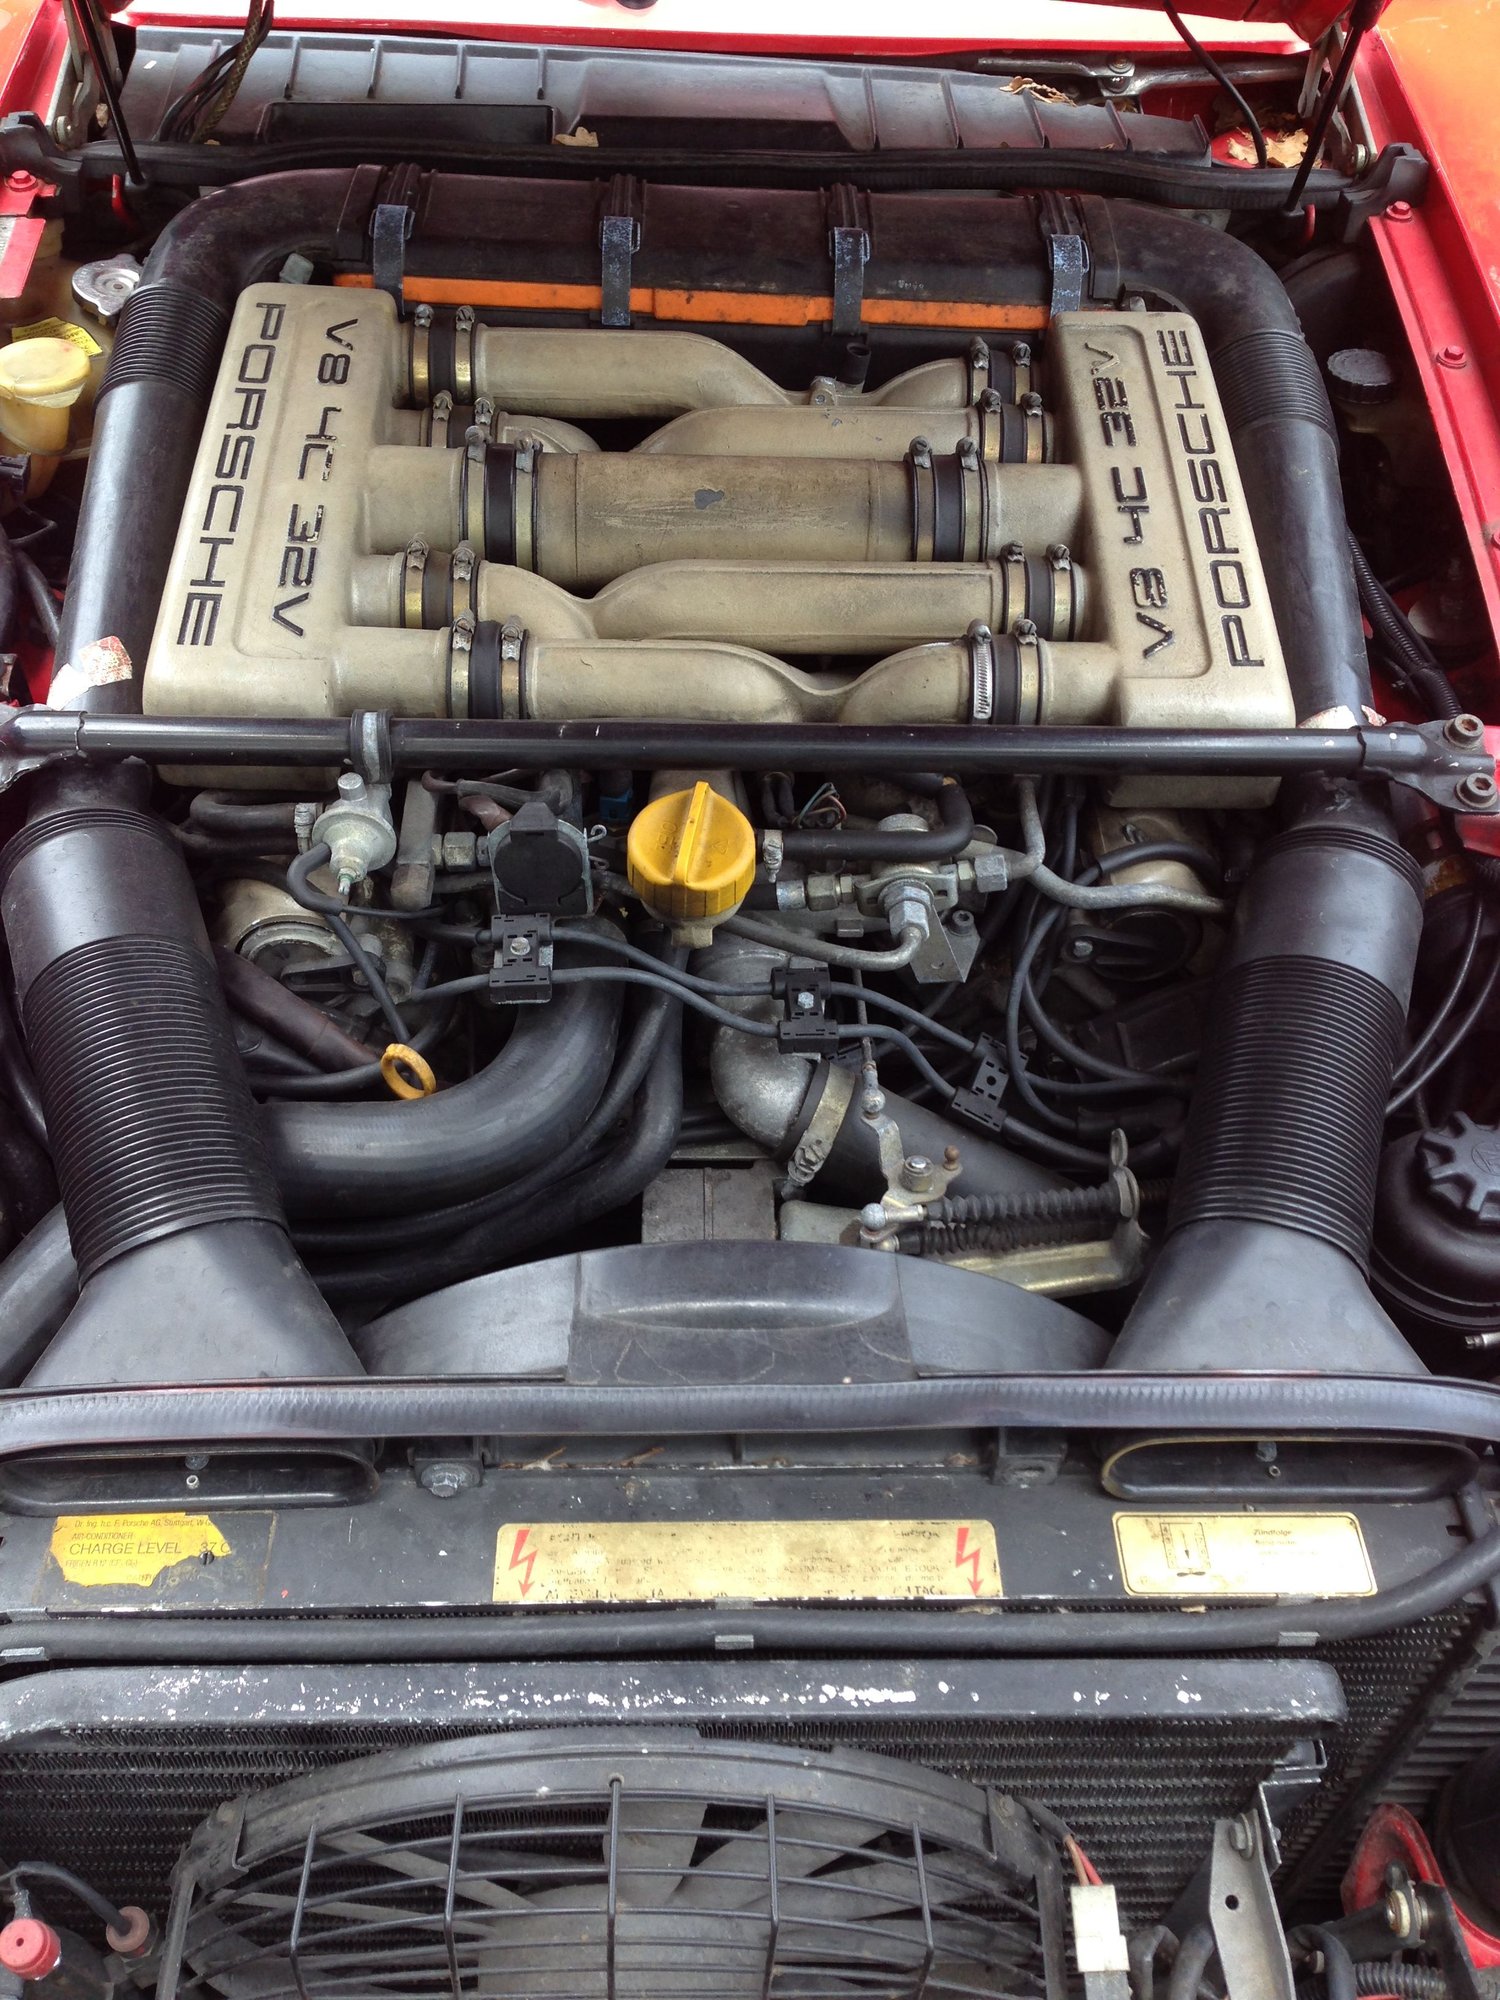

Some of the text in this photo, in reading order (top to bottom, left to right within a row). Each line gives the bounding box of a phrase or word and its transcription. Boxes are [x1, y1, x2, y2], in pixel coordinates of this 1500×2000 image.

[317, 318, 359, 386] V8
[1084, 342, 1139, 448] 32V
[177, 301, 286, 647] PORSCHE
[1156, 329, 1265, 668] PORSCHE
[272, 503, 325, 639] 32V
[1129, 567, 1176, 659] V8
[69, 1542, 134, 1555] CHARGE
[137, 1541, 182, 1554] LEVEL
